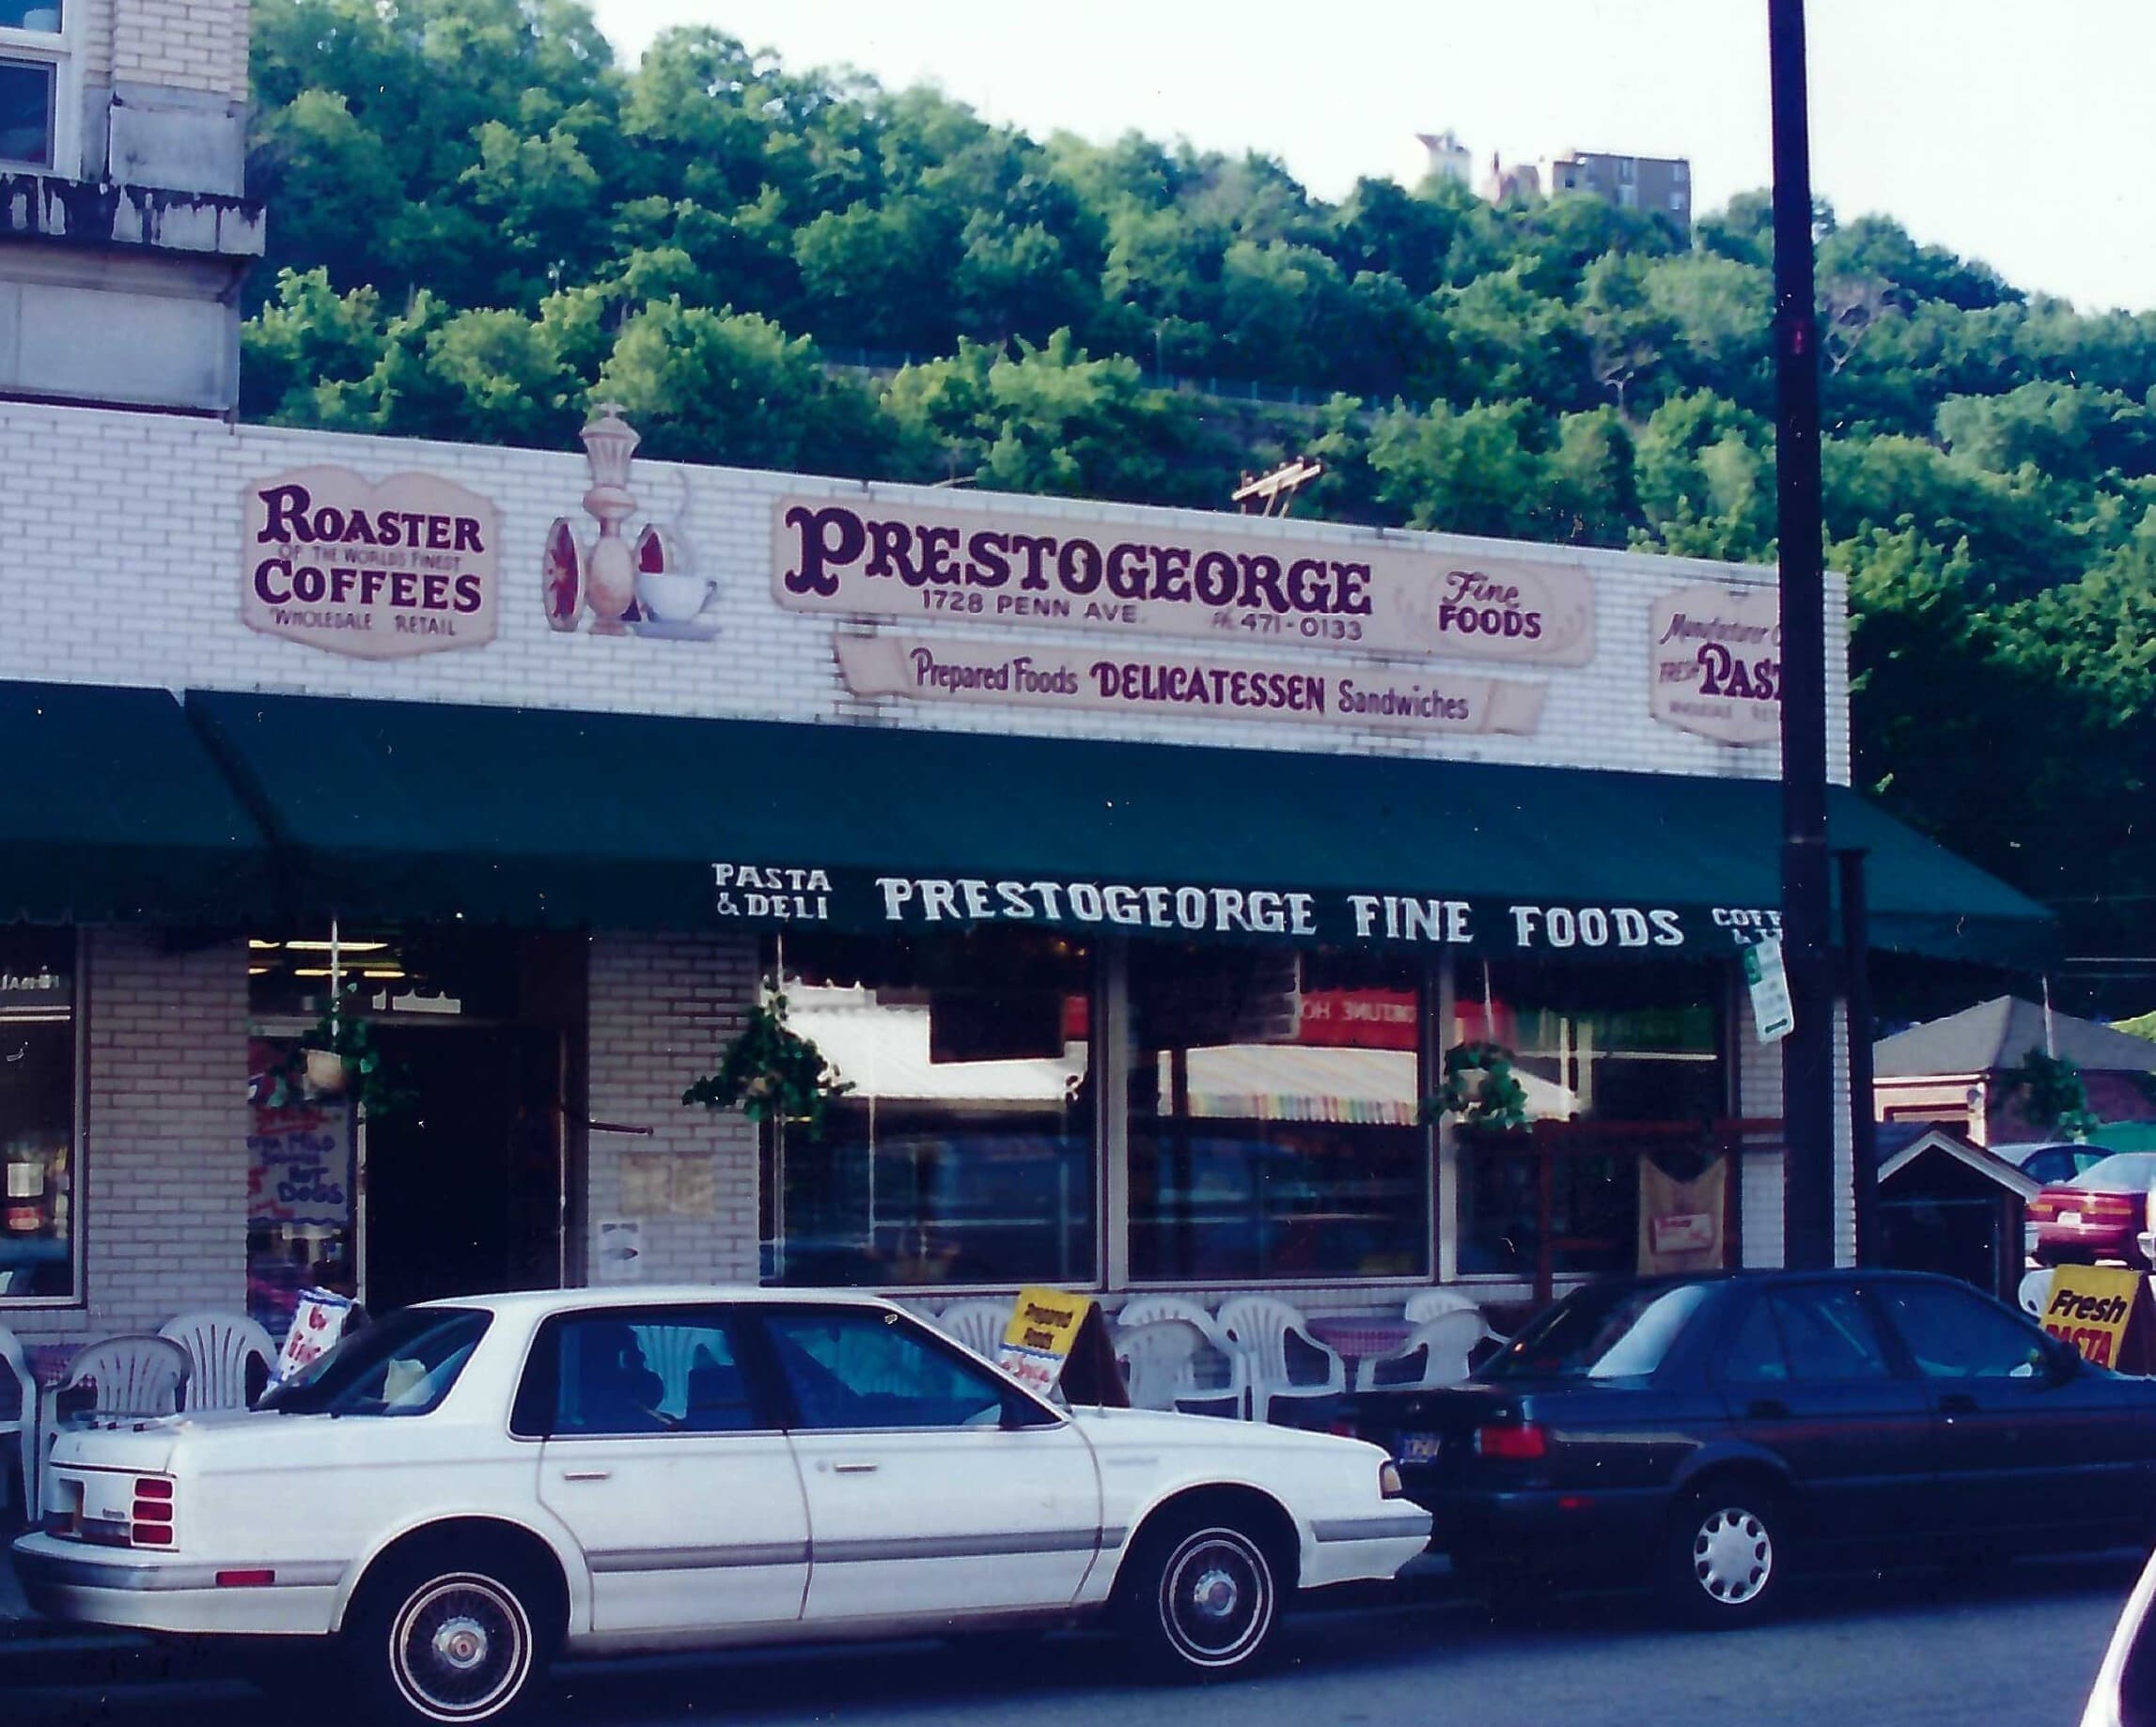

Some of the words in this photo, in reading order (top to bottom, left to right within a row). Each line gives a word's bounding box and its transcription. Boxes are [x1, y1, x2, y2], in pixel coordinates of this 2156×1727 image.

[258, 484, 485, 553] ROASTER
[785, 506, 1373, 615] PRESTOGEORGE
[254, 558, 482, 614] COFFEES
[922, 588, 984, 615] 1728
[996, 595, 1070, 619] PENN
[1442, 570, 1522, 610] Fine
[271, 608, 372, 631] WHOLESALE
[395, 615, 457, 637] RETAIL
[1241, 612, 1364, 642] 471-0133
[1439, 604, 1543, 640] FOODS
[909, 646, 1009, 694] Prepared
[1014, 657, 1079, 695] Foods
[1088, 660, 1326, 715] DELICATESSEN
[1337, 677, 1470, 722] Sandwiches
[1696, 642, 1780, 701] PAS
[711, 862, 834, 892] PASTA
[717, 892, 739, 917] &
[744, 893, 828, 920] DELI
[876, 877, 1317, 937] PRESTOGEORGE
[1347, 894, 1474, 943] FINE
[1509, 904, 1685, 947] FOODS
[1711, 907, 1782, 927] COFF
[2048, 1288, 2128, 1324] Fresh
